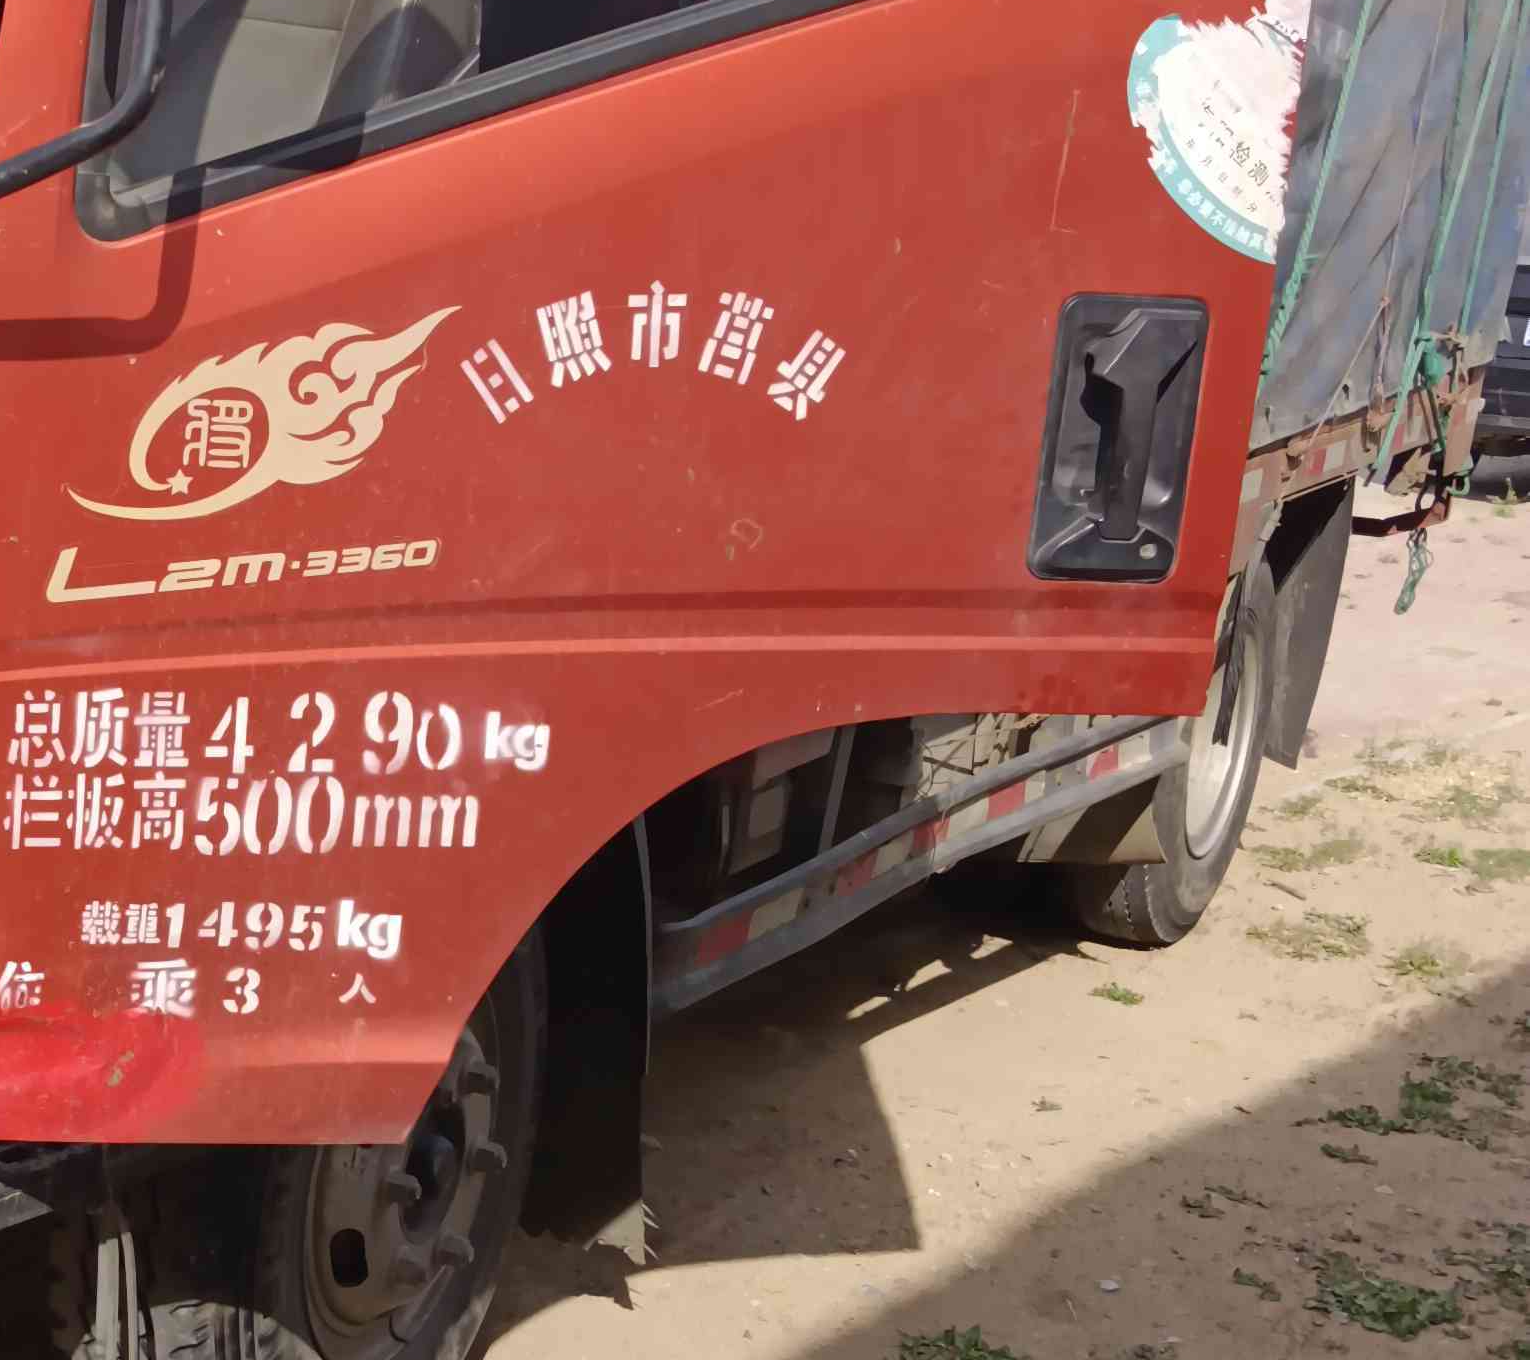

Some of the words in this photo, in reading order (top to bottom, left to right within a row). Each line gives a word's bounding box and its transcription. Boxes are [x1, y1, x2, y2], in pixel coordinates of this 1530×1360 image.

[460, 279, 847, 425] 日照市莒县
